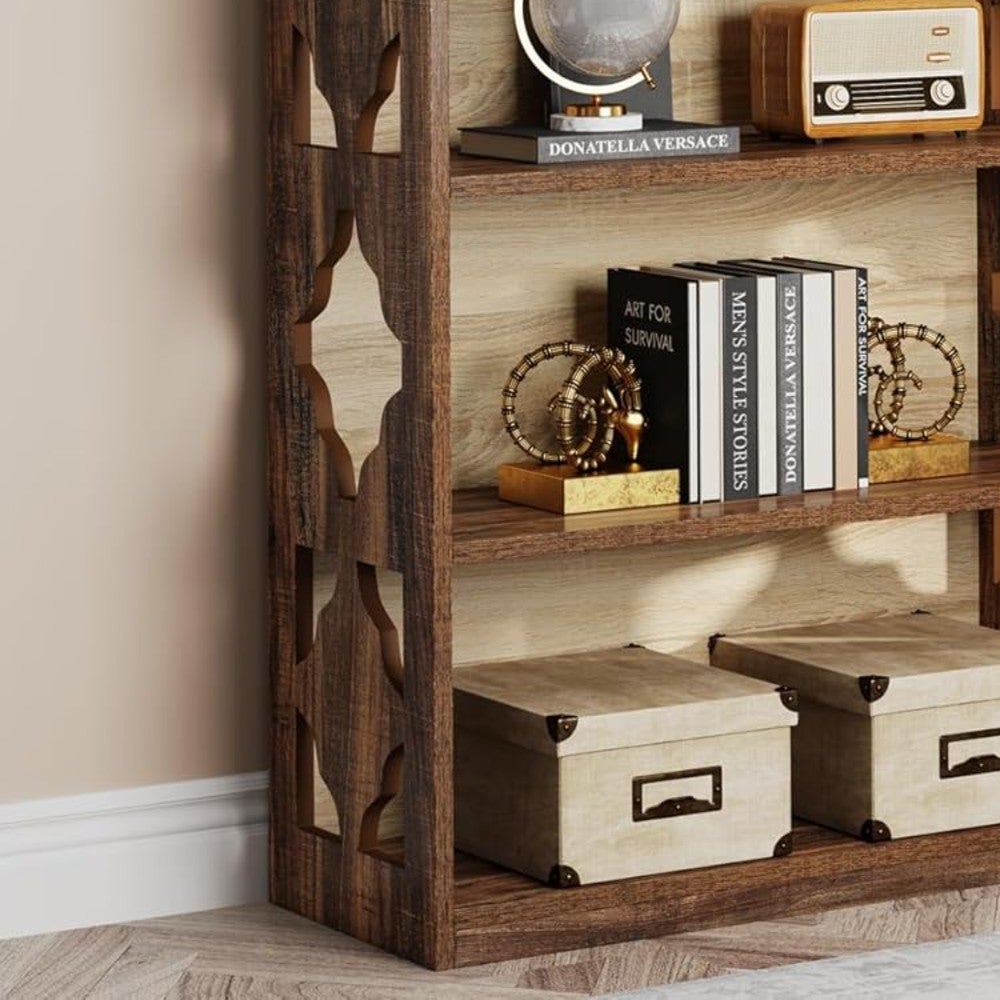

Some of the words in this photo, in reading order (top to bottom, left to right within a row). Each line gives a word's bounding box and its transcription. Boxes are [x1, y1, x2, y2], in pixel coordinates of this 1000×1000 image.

[549, 138, 650, 156] DONATELLA
[653, 133, 729, 150] VERSACE
[624, 300, 645, 317] ART
[648, 303, 672, 324] FOR
[857, 276, 868, 302] ART
[624, 326, 675, 353] SURVIVAL
[731, 291, 748, 348] MEN'S
[784, 285, 797, 371] VERSACE
[857, 305, 868, 334] FOR
[732, 351, 748, 411] STYLE
[858, 336, 868, 397] SURVIVAL
[732, 412, 749, 492] STORIES
[784, 372, 797, 483] DONATELLA
